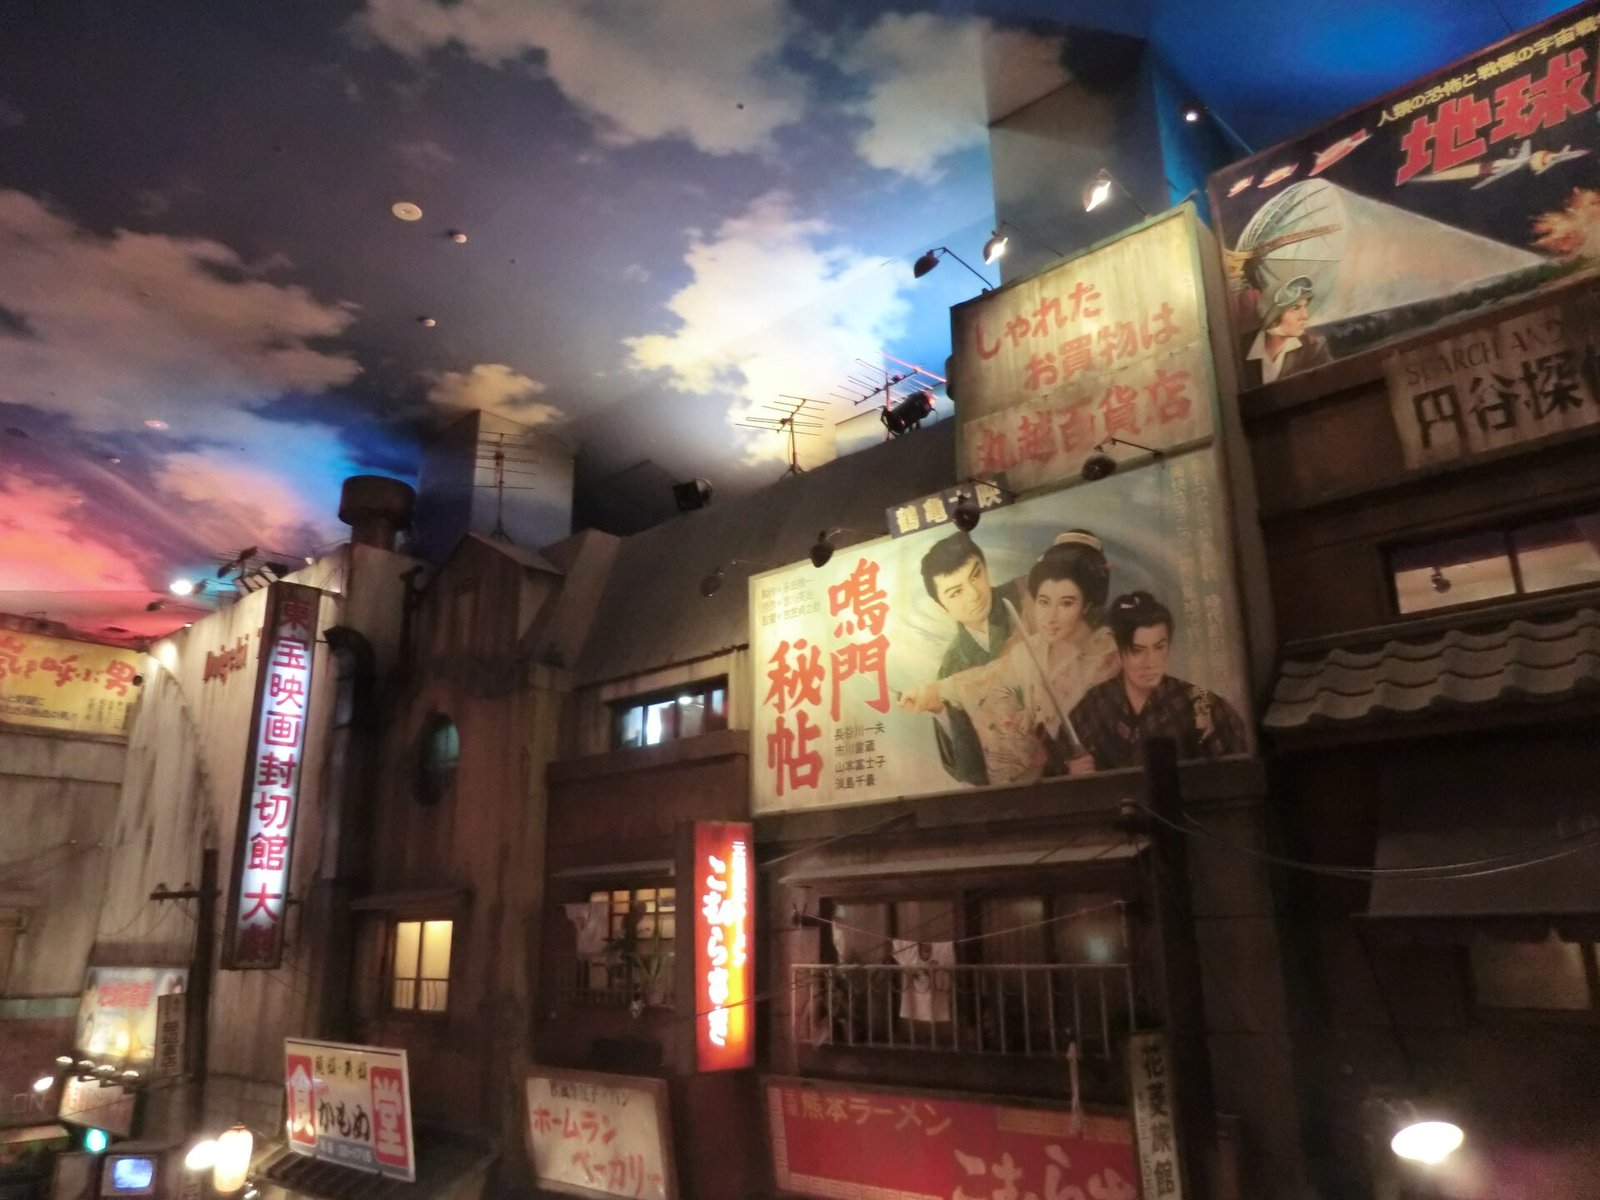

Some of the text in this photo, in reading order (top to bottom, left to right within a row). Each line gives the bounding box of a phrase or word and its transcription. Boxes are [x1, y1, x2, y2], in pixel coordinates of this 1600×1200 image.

[1395, 46, 1600, 187] 地球
[975, 281, 1103, 361] しゃれた
[1023, 302, 1180, 391] お買物は
[1406, 335, 1503, 386] SEARCH
[1413, 344, 1600, 449] 円谷探
[827, 557, 891, 722] 鳴門
[765, 638, 826, 796] 秘帖
[317, 1099, 371, 1142] かもめ
[532, 1107, 619, 1146] ホームラン
[800, 1090, 952, 1138] 熊本ラーメン
